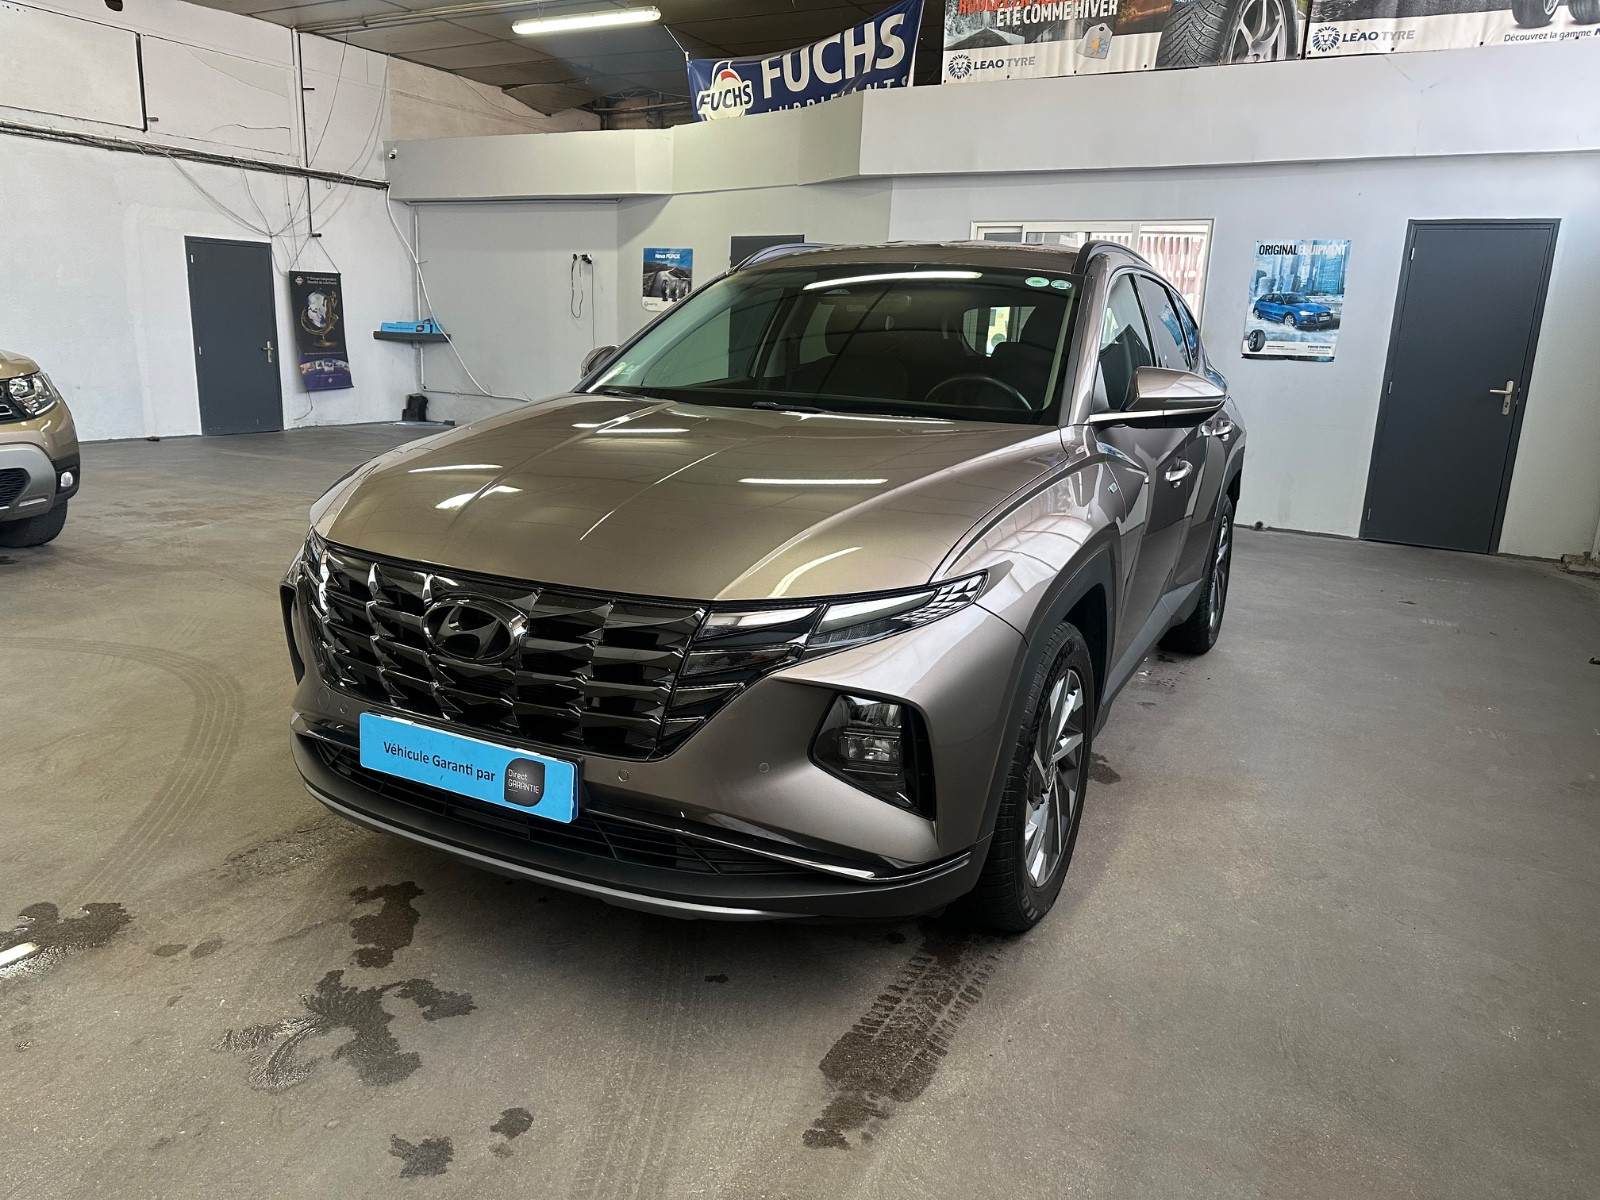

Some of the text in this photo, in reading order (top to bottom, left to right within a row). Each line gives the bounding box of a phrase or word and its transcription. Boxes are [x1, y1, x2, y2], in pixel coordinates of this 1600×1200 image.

[1023, 1, 1072, 24] COMME
[1074, 0, 1118, 19] HIVER
[1342, 30, 1415, 43] LEAO TYRE
[1504, 32, 1548, 42] Découvrez
[1550, 31, 1557, 39] la
[1559, 30, 1592, 41] gamme
[761, 13, 905, 99] FUCHS
[974, 56, 1036, 70] LEAO TYRE
[697, 83, 752, 111] FUCHS
[1259, 244, 1298, 256] ORIGINAL
[383, 741, 496, 782] Véhicule Garanti par
[508, 768, 528, 781] Direct
[507, 778, 540, 794] GARANTIE
